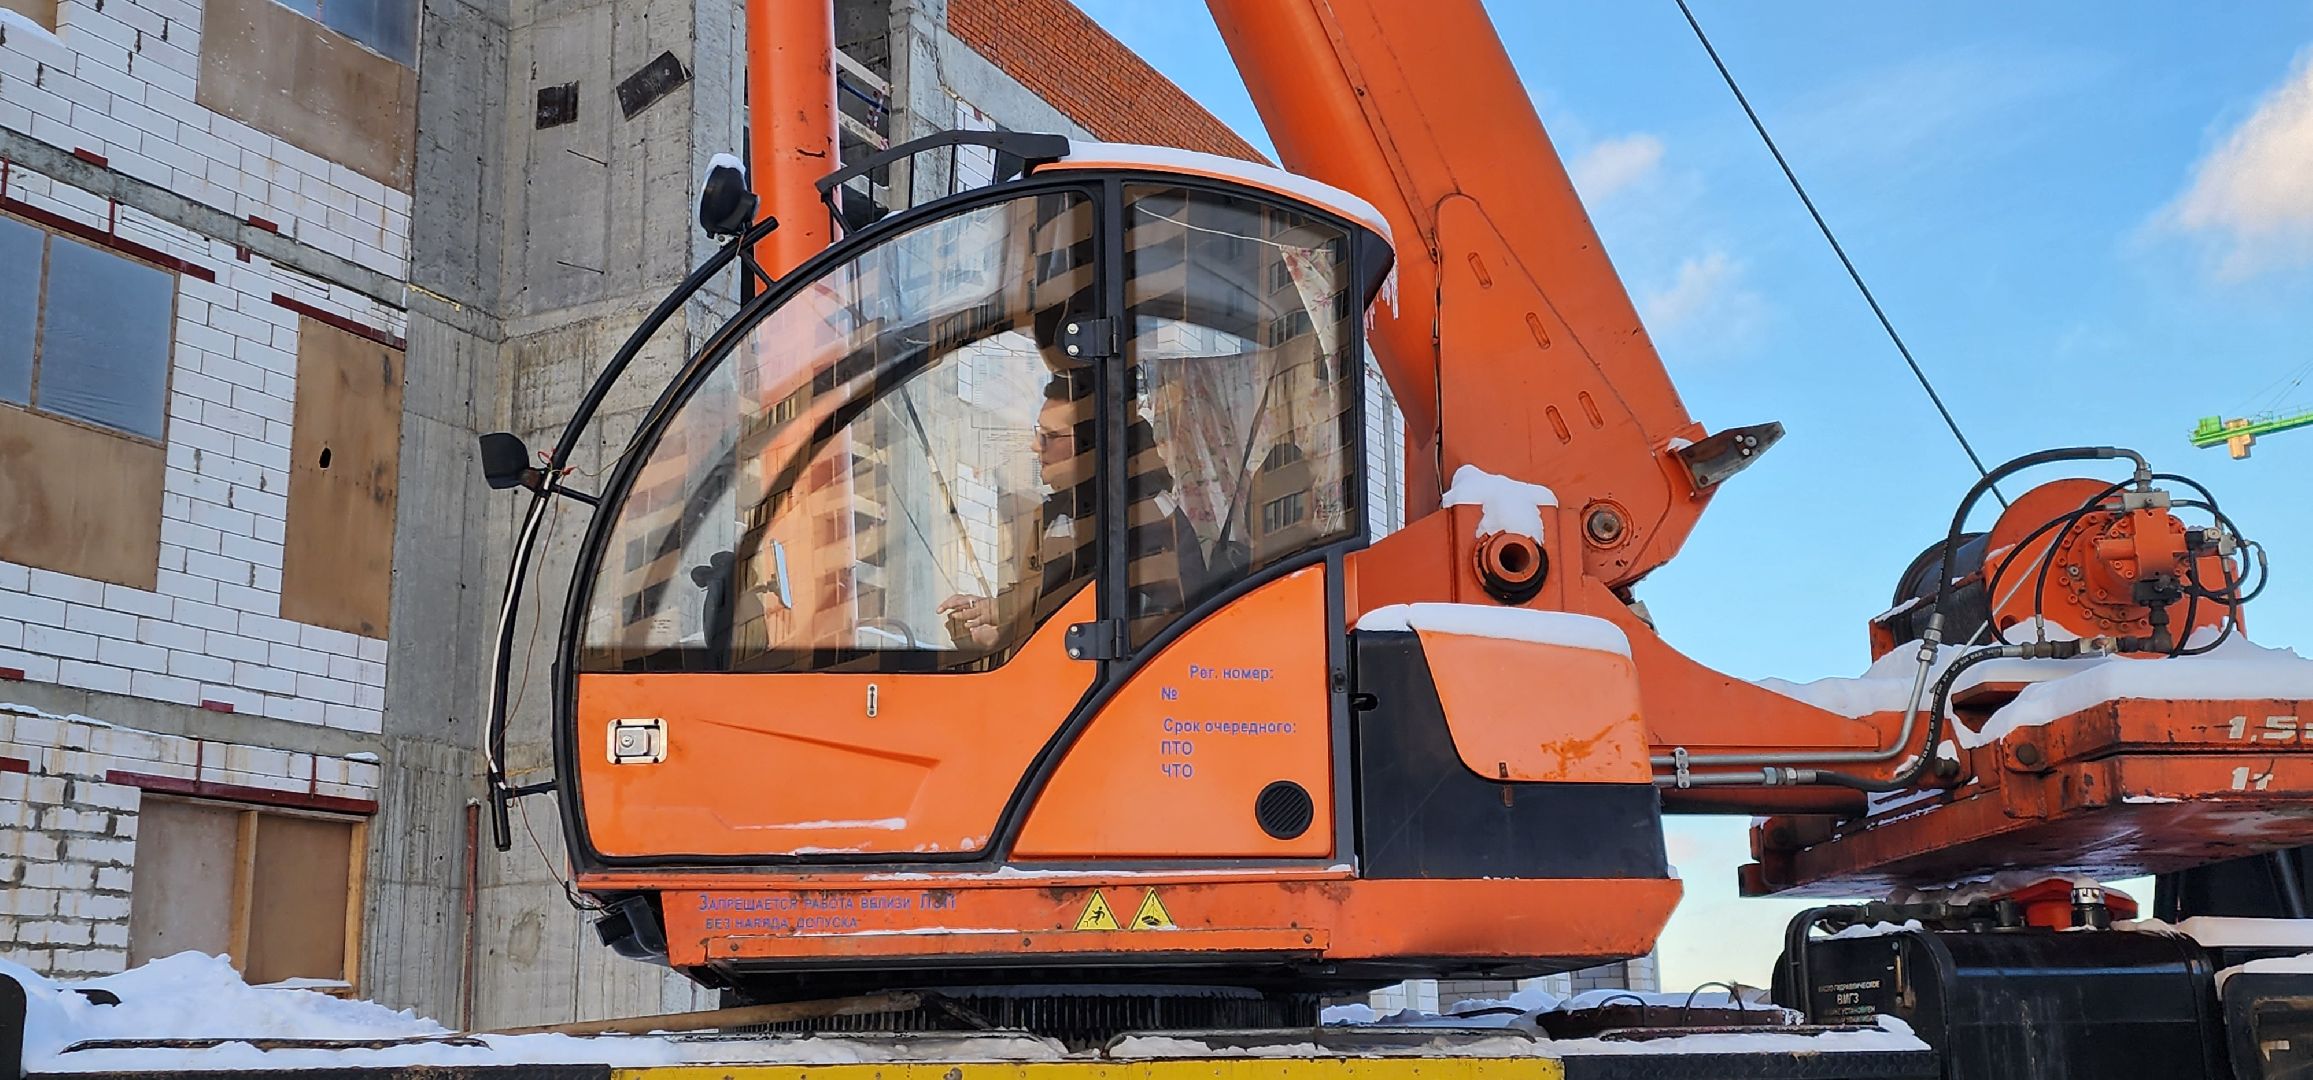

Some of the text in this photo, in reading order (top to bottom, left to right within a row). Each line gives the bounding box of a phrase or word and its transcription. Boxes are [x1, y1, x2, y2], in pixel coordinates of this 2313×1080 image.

[1189, 665, 1274, 682] Рег. номер:
[1161, 687, 1178, 700] №
[1163, 718, 1296, 736] Срок очередного:
[1161, 741, 1193, 755] ПТО
[1161, 764, 1193, 778] ЧТО
[861, 896, 912, 909] ВБЛИЗИ
[706, 918, 731, 930] БЕЗ
